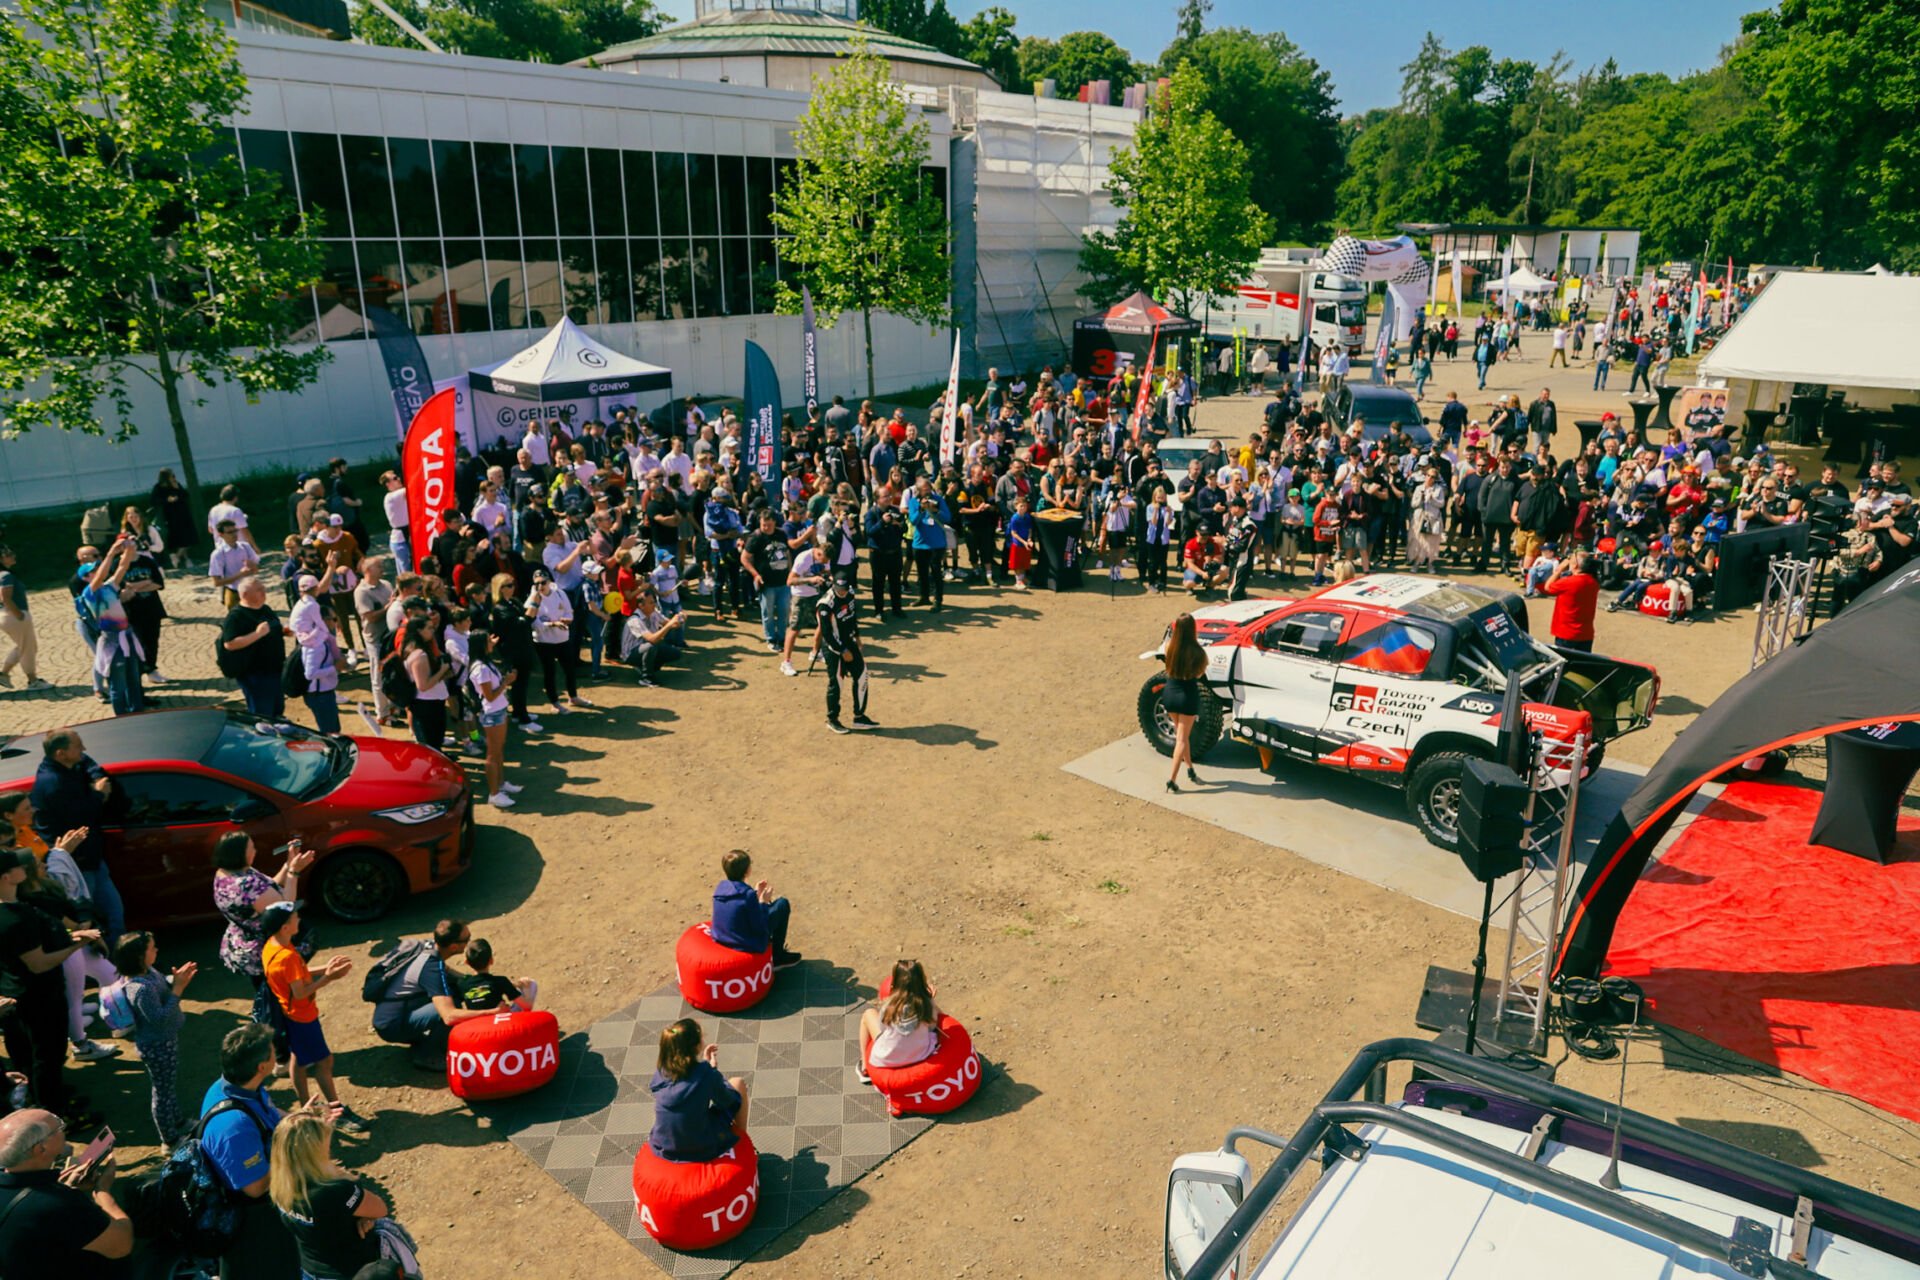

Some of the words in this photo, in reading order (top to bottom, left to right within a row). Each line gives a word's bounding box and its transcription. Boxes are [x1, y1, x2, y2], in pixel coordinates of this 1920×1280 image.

[599, 381, 630, 391] GENEVO
[420, 427, 444, 552] YOTA
[1332, 691, 1374, 713] GR
[1378, 698, 1426, 711] GAZOO
[1381, 688, 1435, 703] TOYOTA
[1377, 707, 1422, 722] Racing
[1459, 699, 1494, 714] NEXO
[1346, 716, 1405, 736] Czech
[705, 962, 772, 999] TOYO
[449, 1043, 556, 1077] TOYOTA
[904, 1055, 979, 1104] TOYO
[702, 1173, 758, 1232] TOY
